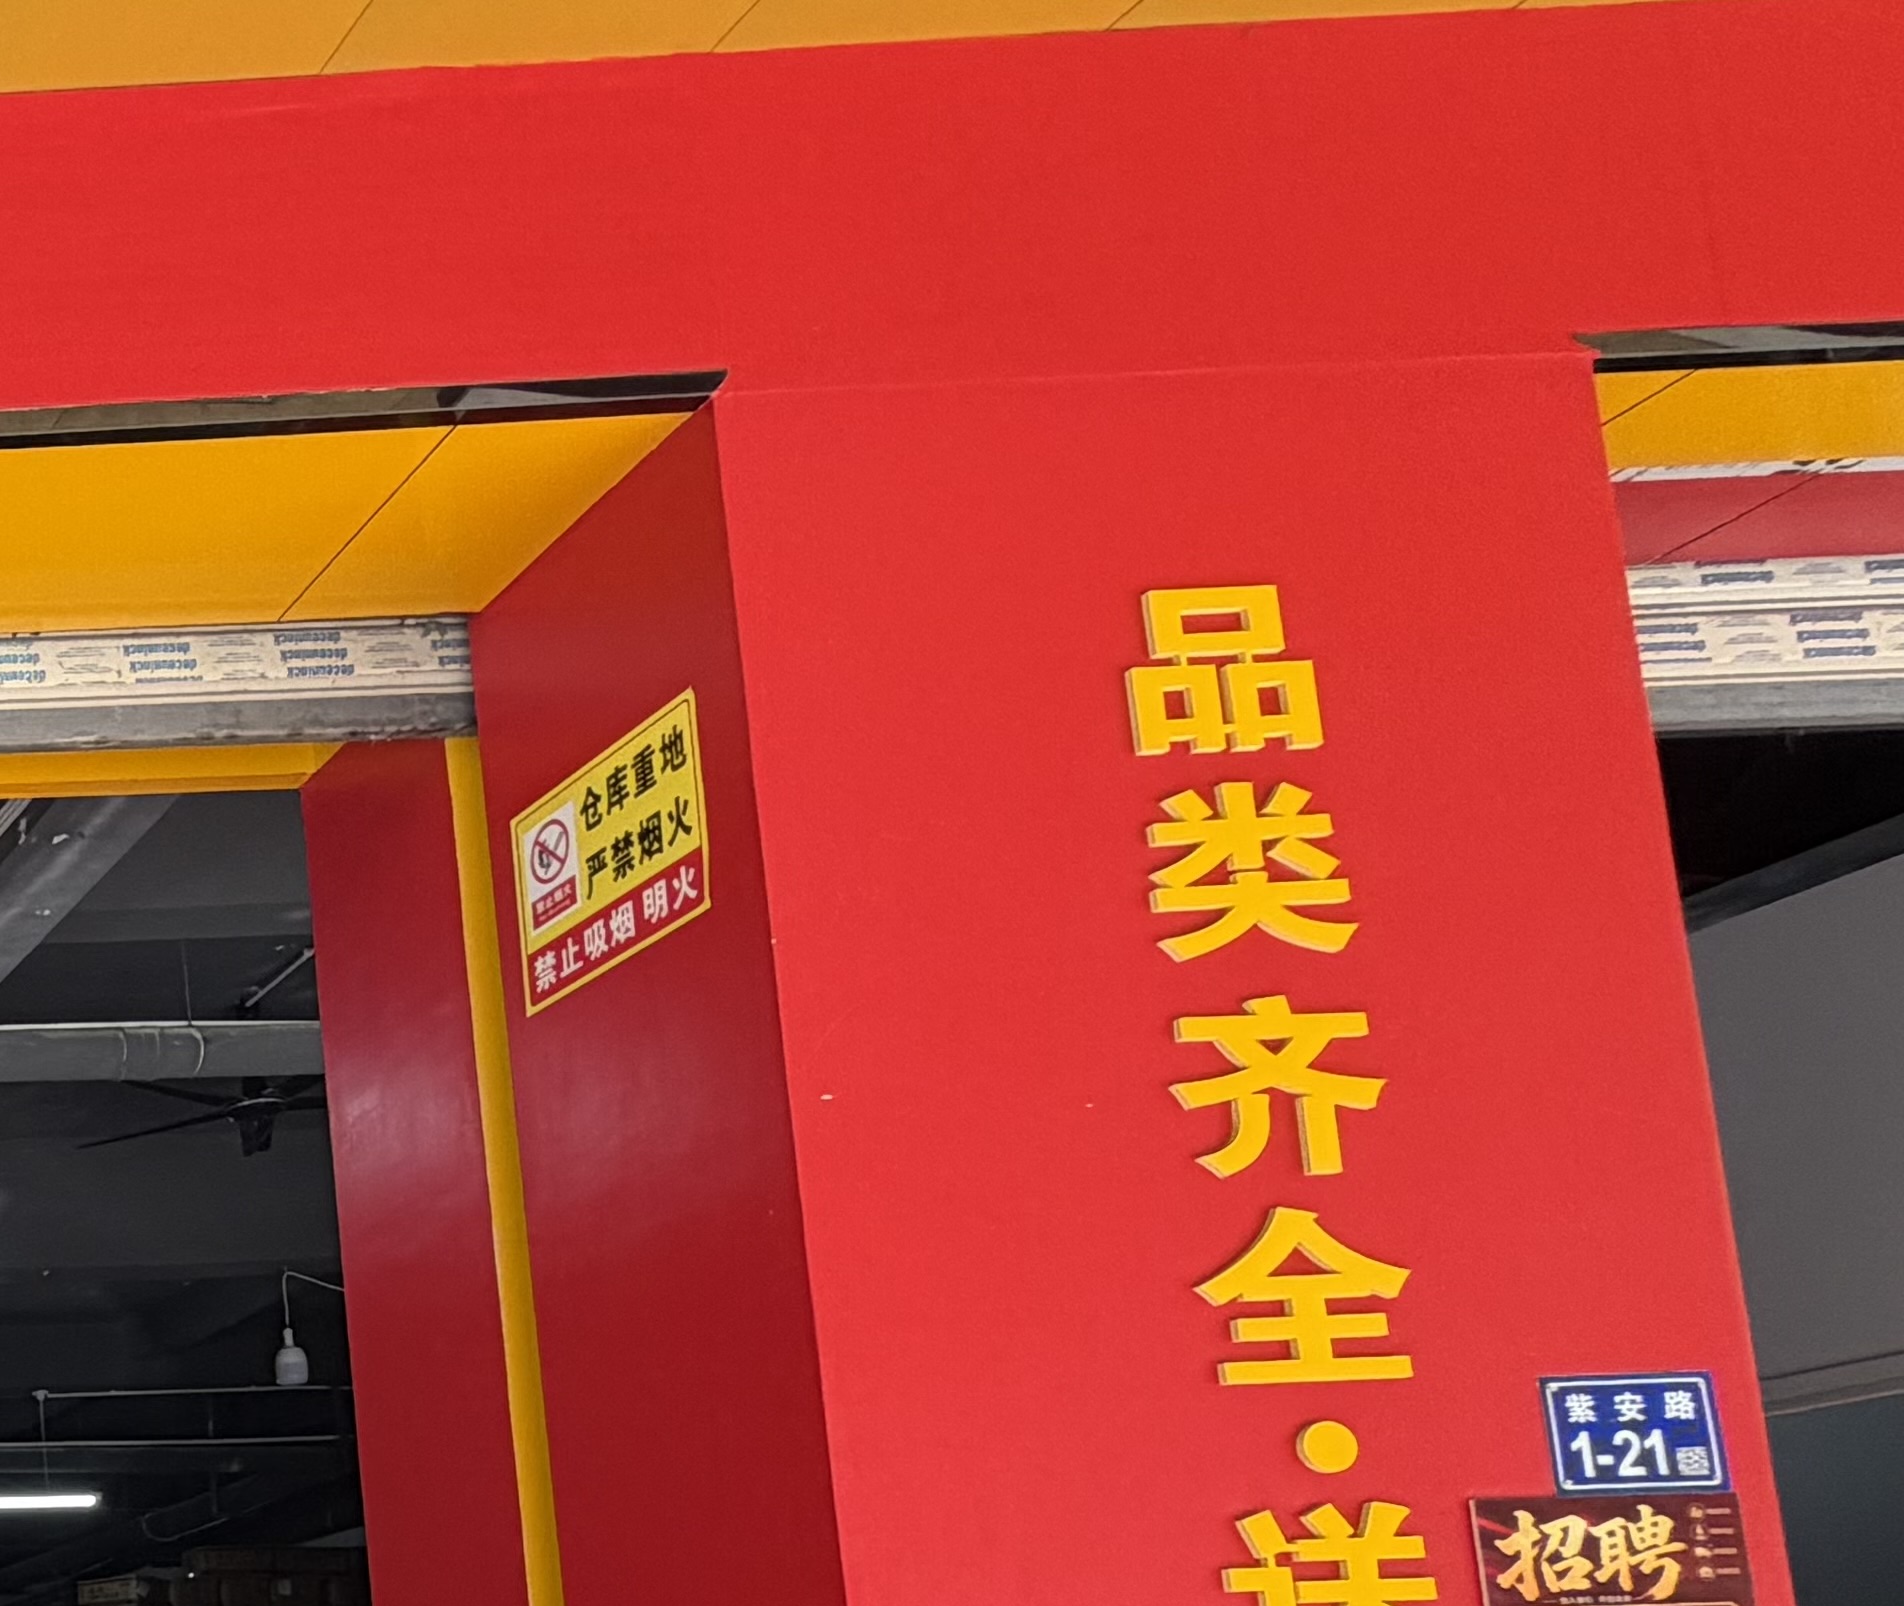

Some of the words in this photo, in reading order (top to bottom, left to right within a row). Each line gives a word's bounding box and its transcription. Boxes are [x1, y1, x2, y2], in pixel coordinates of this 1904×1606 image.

[578, 723, 688, 833] 仓库重地
[585, 795, 694, 900] 严禁烟火
[534, 900, 636, 994] 禁止吸烟
[642, 865, 699, 923] 明火
[1564, 1390, 1696, 1423] 紫安路
[1570, 1428, 1671, 1478] 1-21
[1493, 1504, 1689, 1602] 招聘
